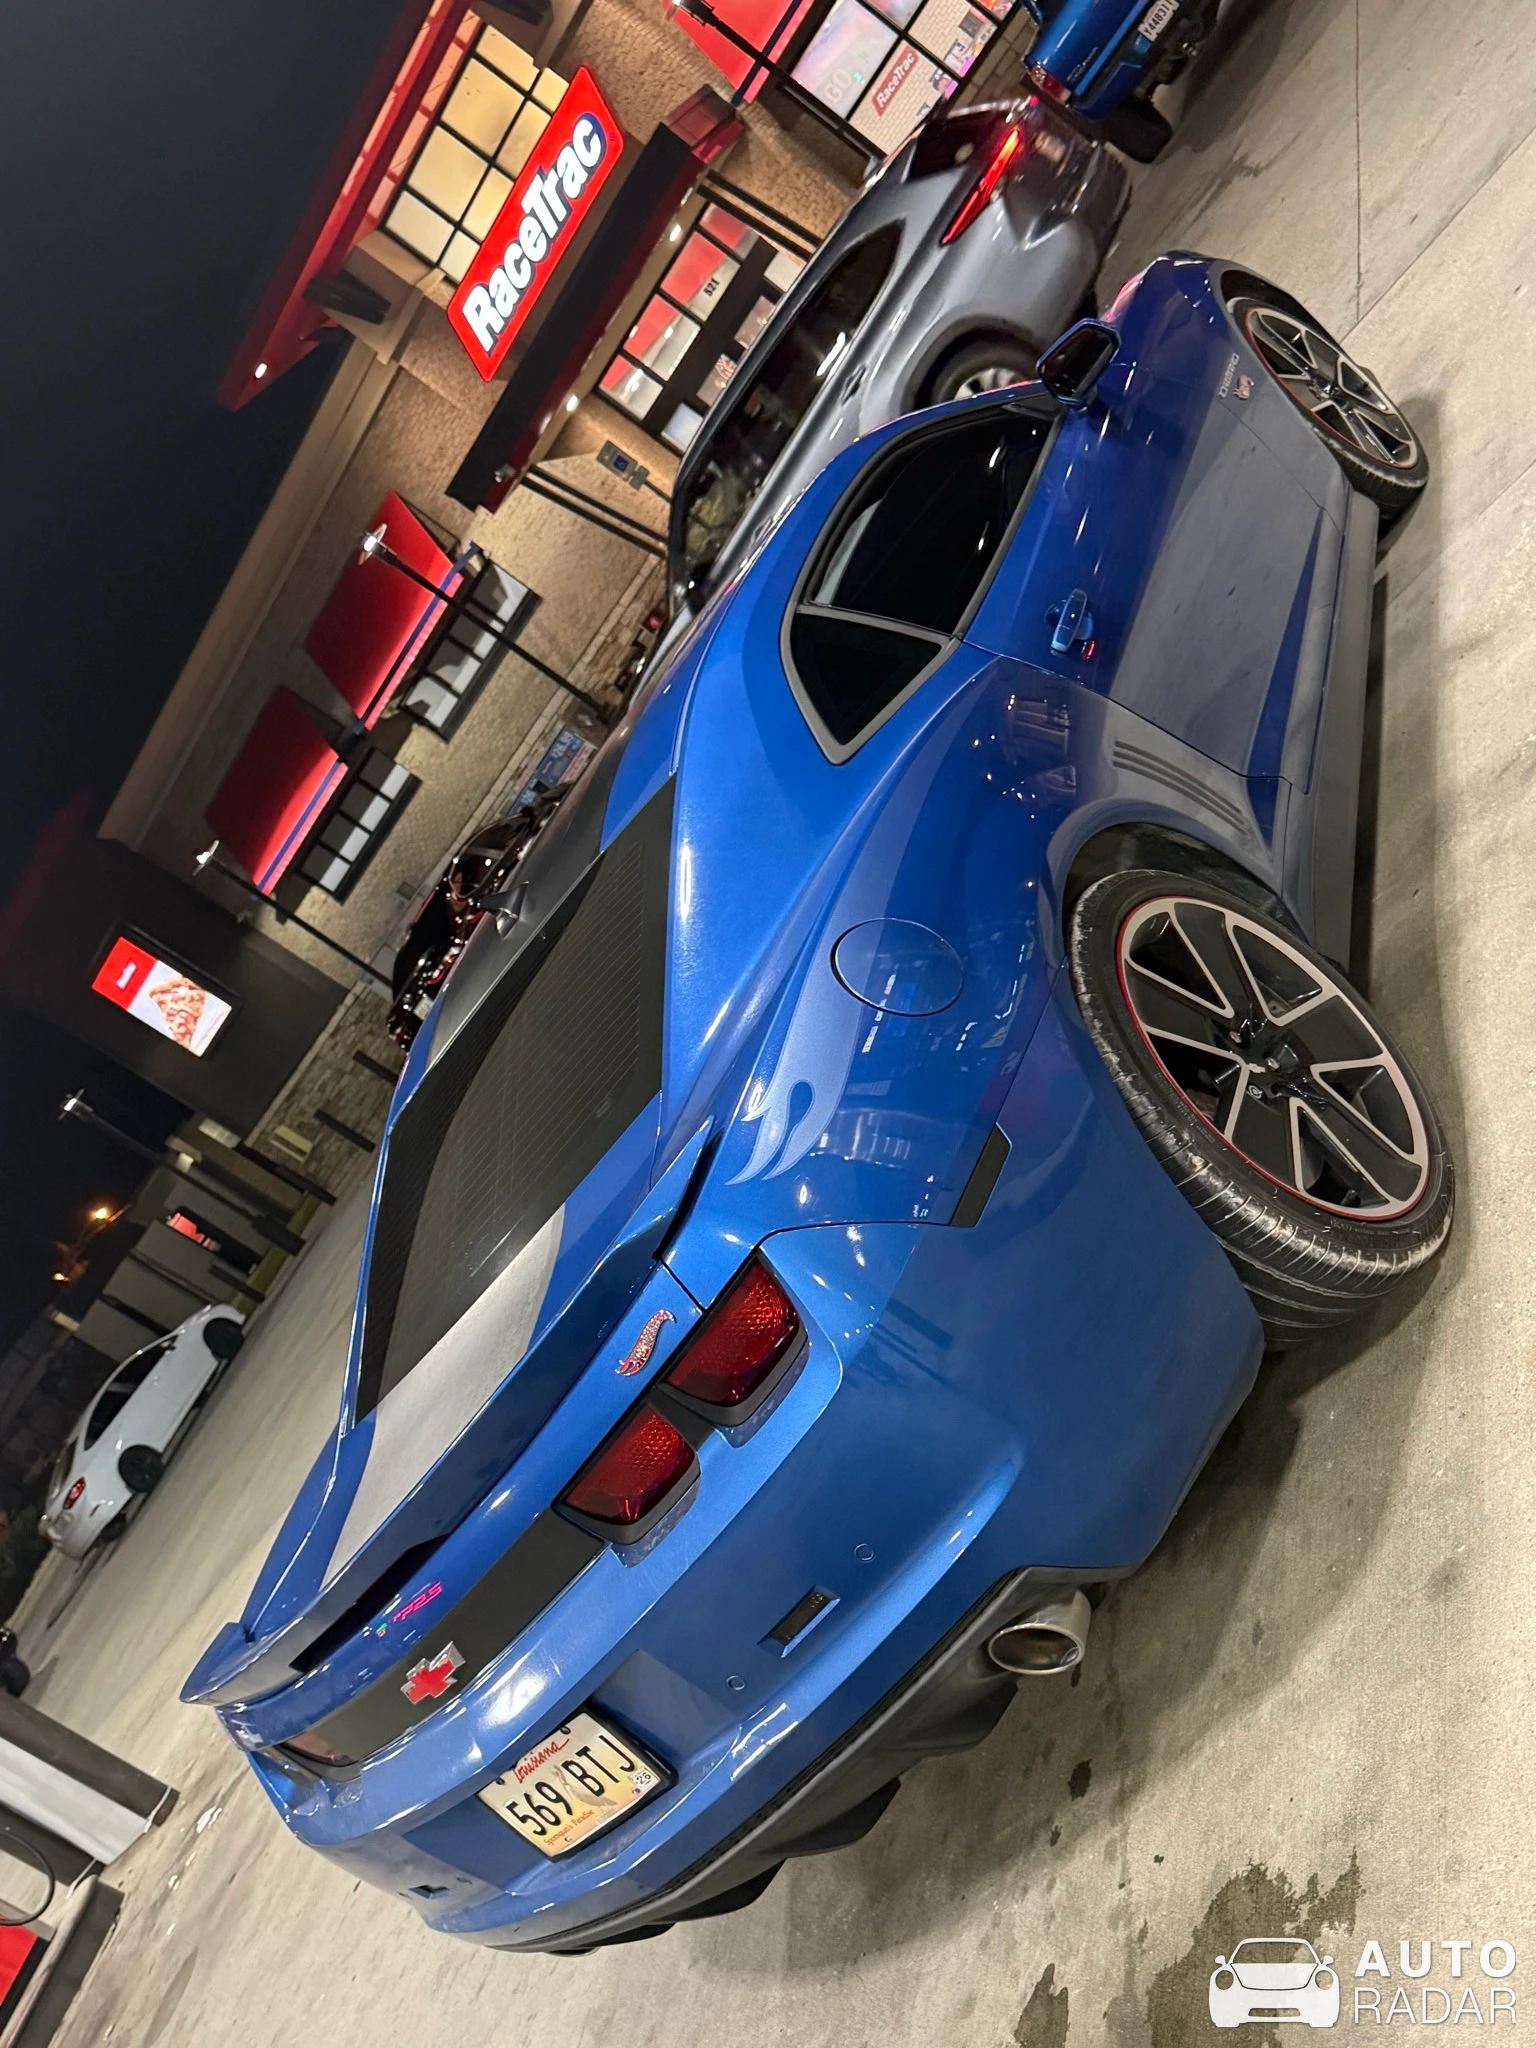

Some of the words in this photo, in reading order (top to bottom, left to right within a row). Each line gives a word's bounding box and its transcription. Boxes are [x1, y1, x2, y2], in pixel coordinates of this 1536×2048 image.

[875, 51, 916, 109] RaceTrac
[462, 115, 605, 354] RaceTrac
[703, 277, 720, 297] 521
[506, 1781, 573, 1836] 569
[561, 1735, 635, 1797] BTJ
[513, 1738, 570, 1784] Louisiana
[572, 1809, 595, 1827] Paradise
